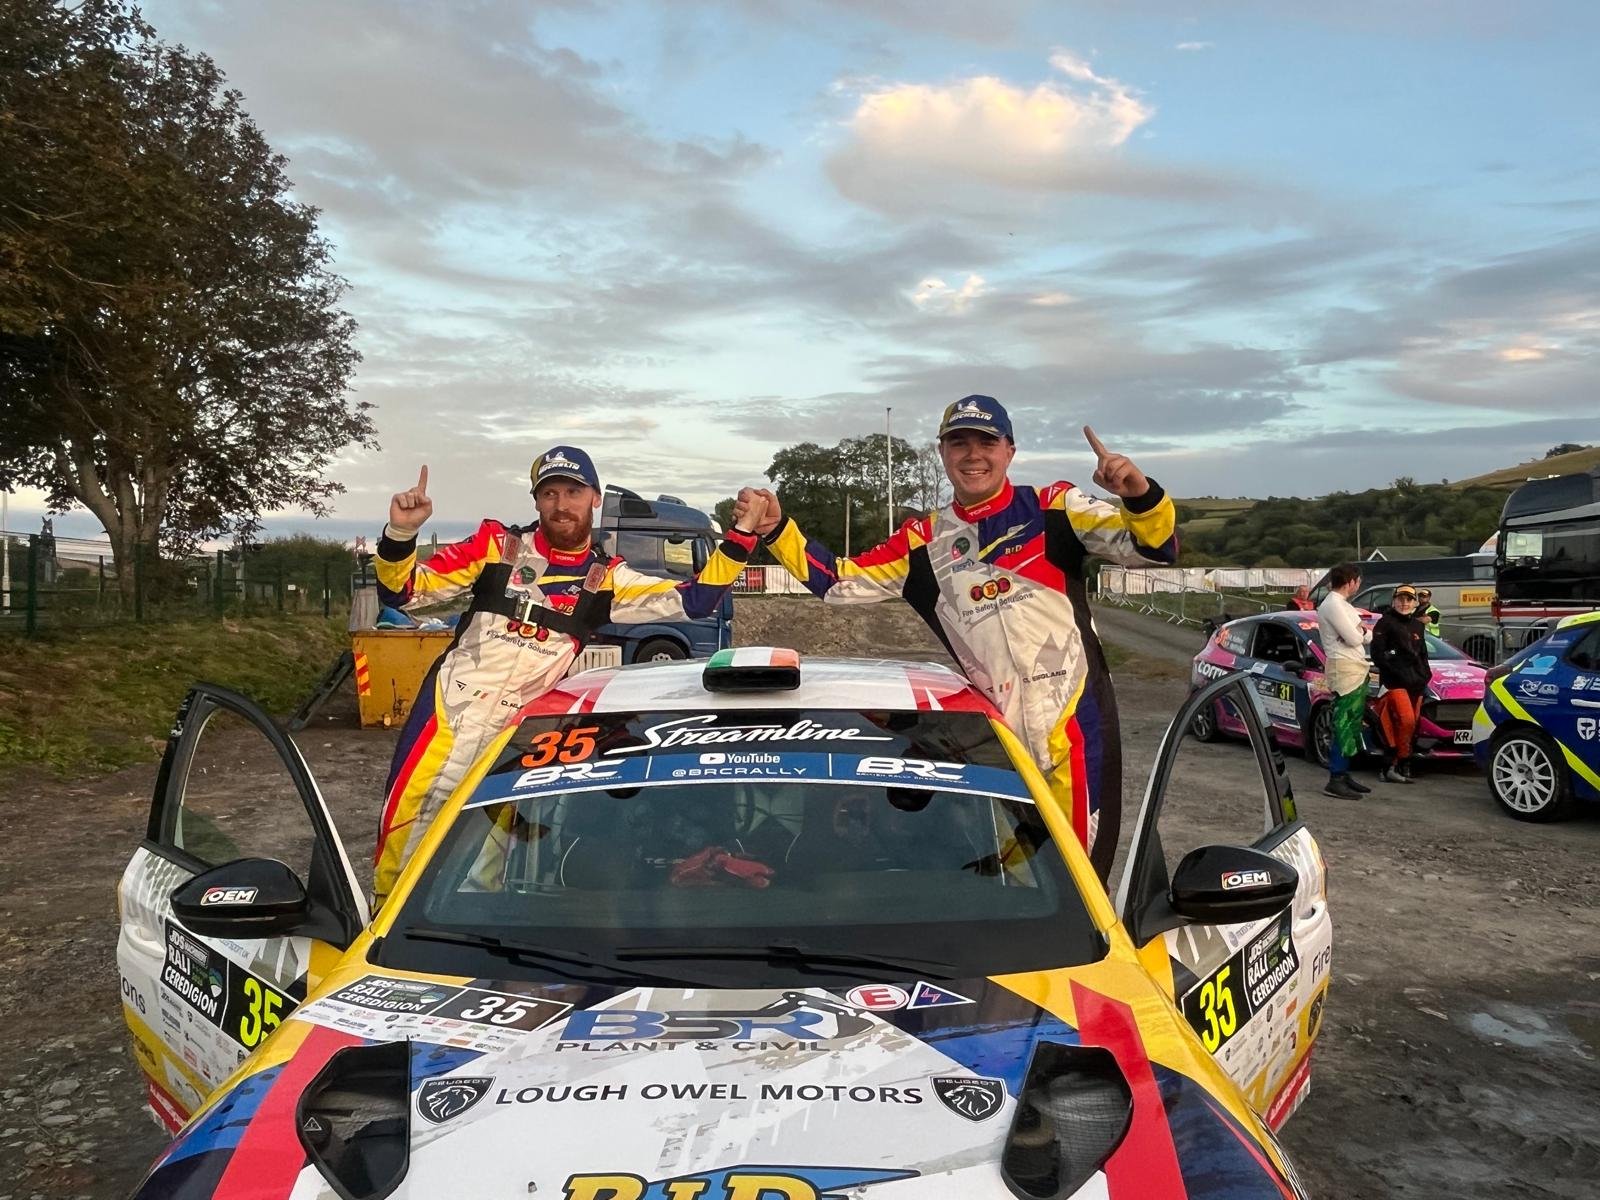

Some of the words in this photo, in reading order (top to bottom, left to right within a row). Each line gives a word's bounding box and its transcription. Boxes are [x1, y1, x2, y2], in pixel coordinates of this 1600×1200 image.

[975, 602, 998, 614] Safety
[1280, 683, 1290, 700] 31
[603, 714, 893, 756] Streamline
[521, 727, 600, 768] 35
[727, 753, 780, 765] YouTube
[512, 759, 626, 789] BRC
[671, 767, 807, 778] @BRCRALLY
[856, 756, 967, 781] BRC
[1227, 873, 1268, 886] OEM
[208, 890, 254, 902] OEM
[168, 944, 191, 976] RALI
[1247, 953, 1269, 988] RALI
[1312, 945, 1331, 984] Fire
[164, 966, 218, 1018] CEREDIGION
[349, 984, 392, 999] RALI
[1252, 954, 1296, 1007] CEREDIGION
[122, 976, 147, 1015] ons
[337, 991, 427, 1012] CEREDIGION
[859, 988, 897, 1006] E
[240, 977, 283, 1047] 35
[461, 996, 538, 1025] 35
[1199, 965, 1237, 1053] 35
[555, 1041, 678, 1053] PLANT
[694, 1041, 719, 1053] &
[732, 1041, 831, 1053] CIVIL
[428, 1078, 488, 1087] PEUGEOT
[495, 1084, 628, 1105] LOUGH
[640, 1083, 748, 1101] OWEL
[760, 1083, 924, 1105] MOTORS
[937, 1078, 997, 1087] PEUGEOT
